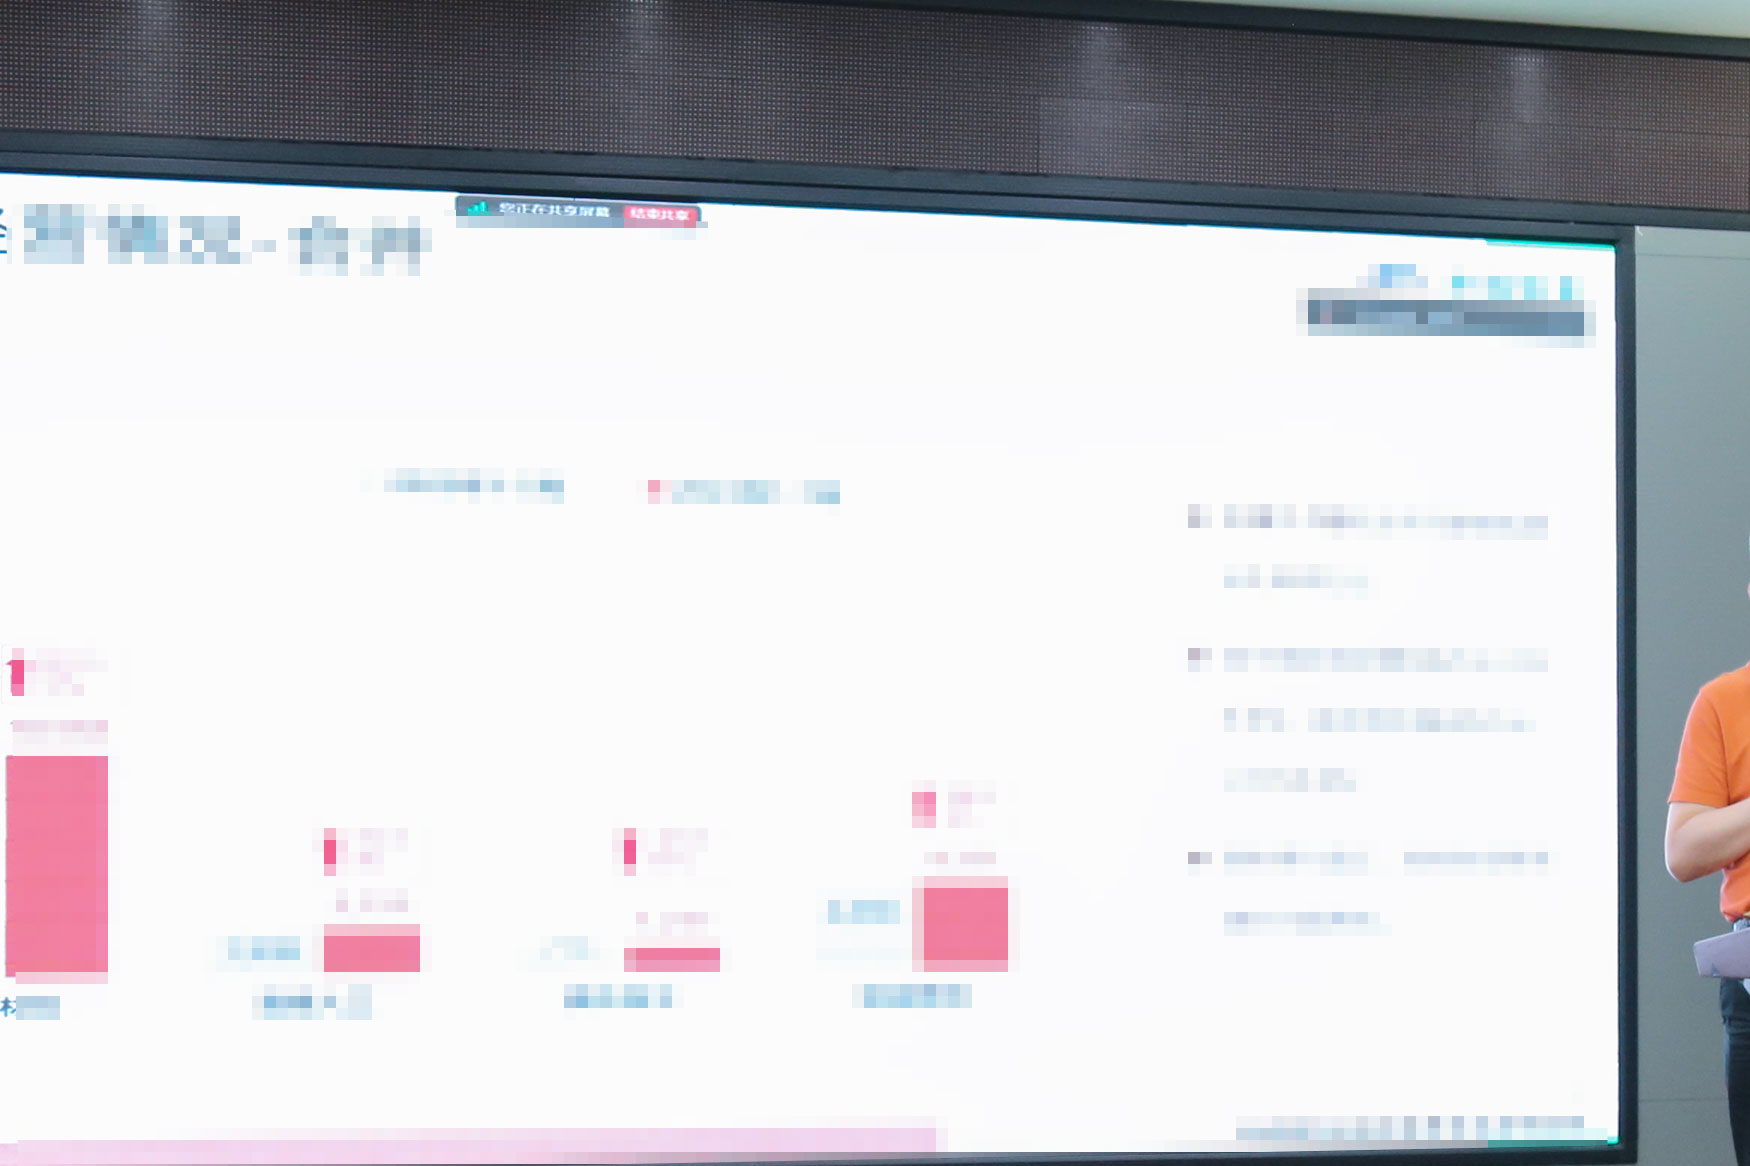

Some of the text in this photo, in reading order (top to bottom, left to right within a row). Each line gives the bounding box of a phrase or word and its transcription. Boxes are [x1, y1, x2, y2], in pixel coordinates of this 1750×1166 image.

[499, 202, 610, 217] 您正在共享屏幕
[630, 207, 690, 221] 结束共享
